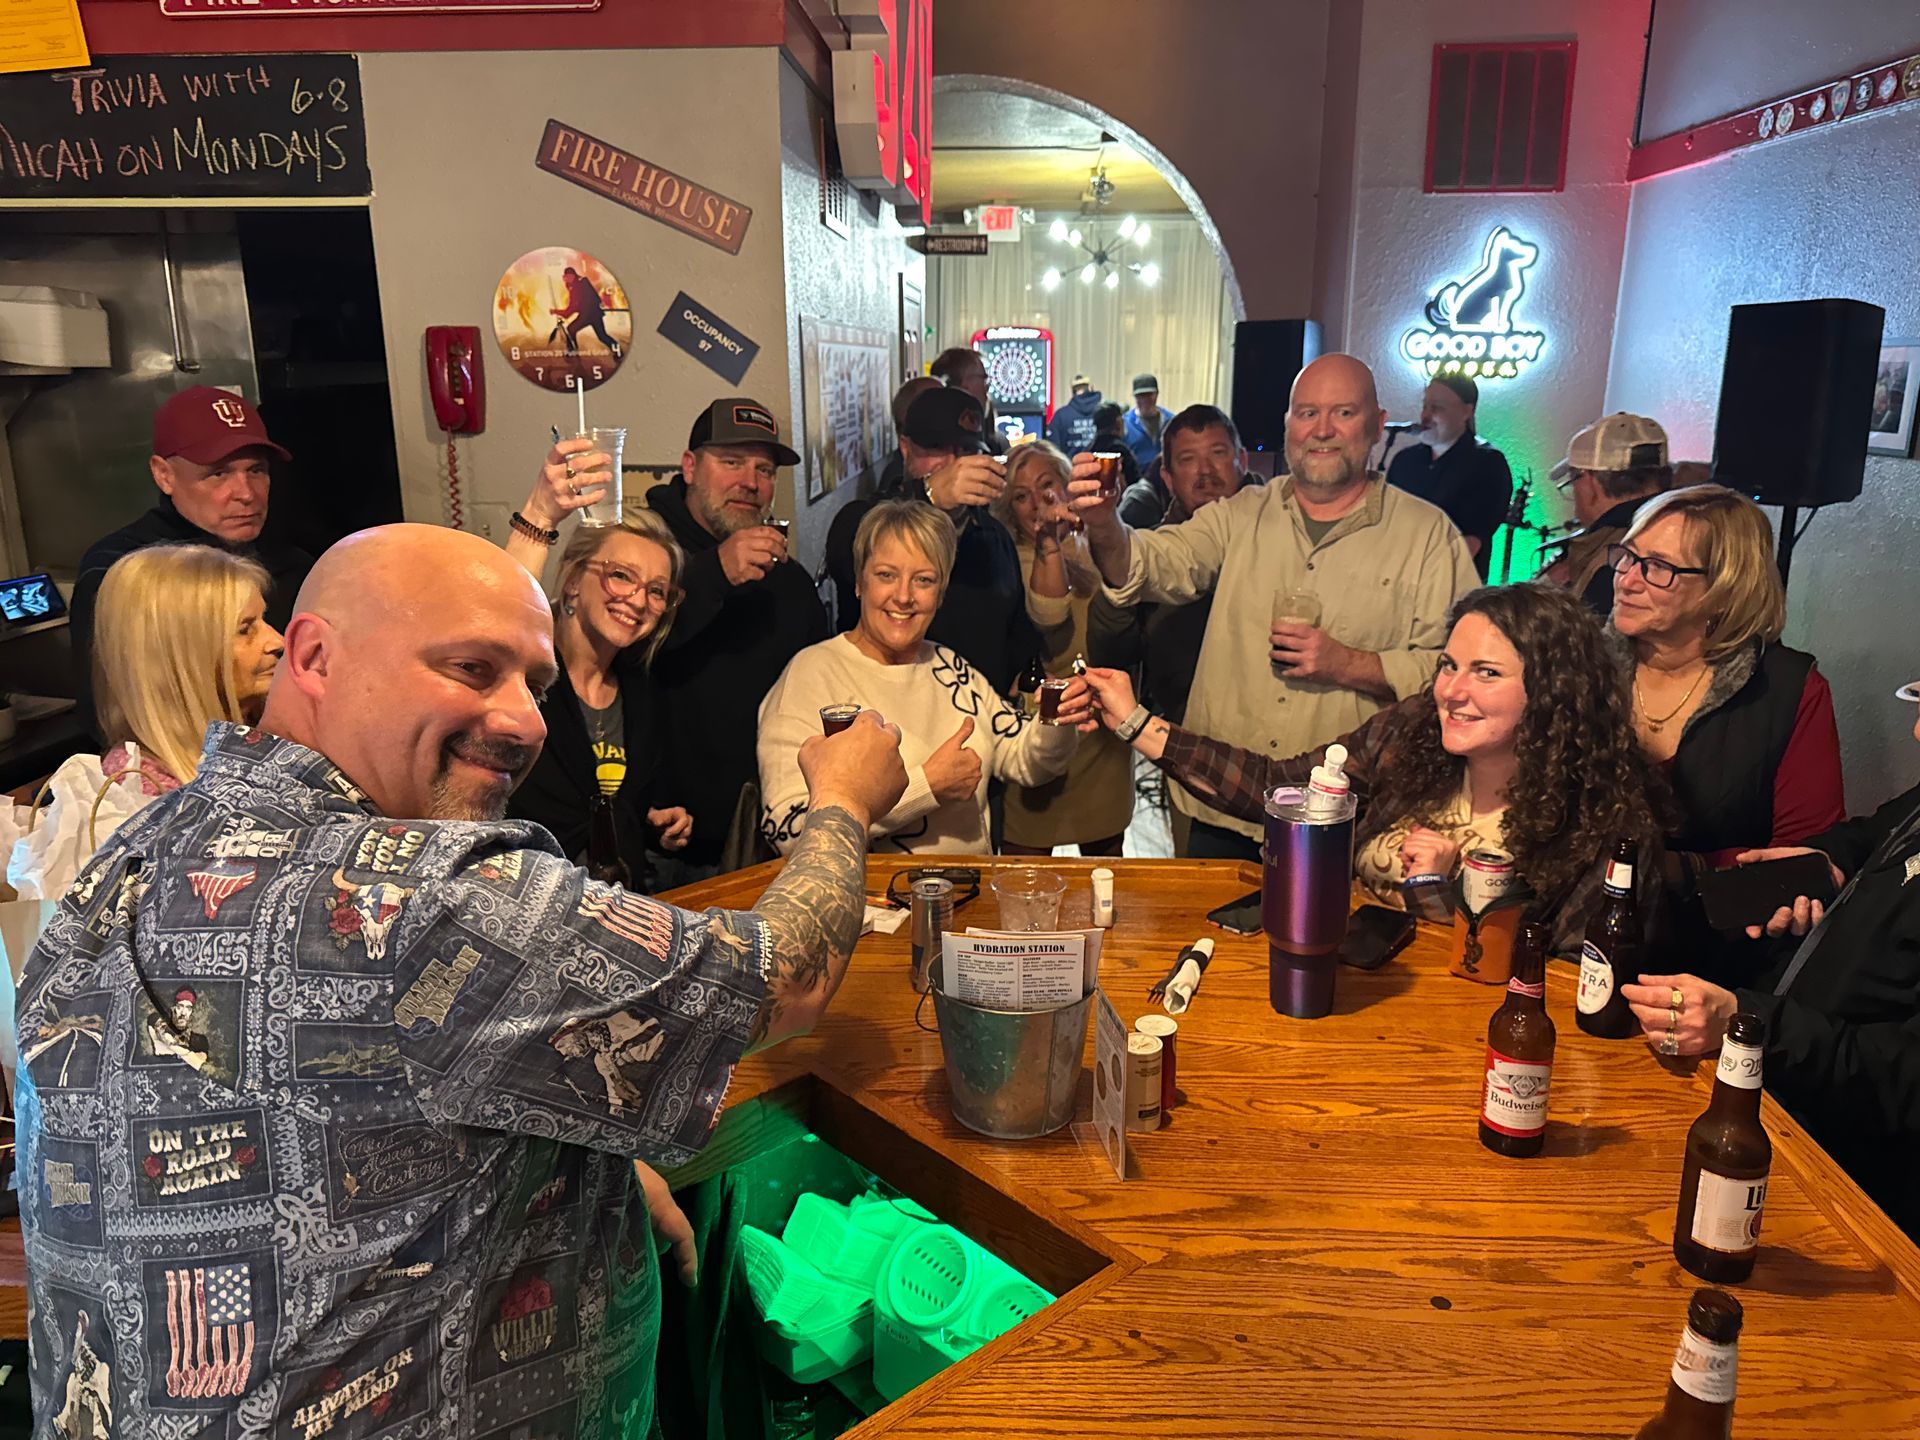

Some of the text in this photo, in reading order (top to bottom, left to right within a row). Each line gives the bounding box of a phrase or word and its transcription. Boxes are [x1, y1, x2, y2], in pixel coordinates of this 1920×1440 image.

[52, 68, 168, 115] TRIVIA
[183, 64, 271, 103] WITH
[117, 134, 164, 176] ON
[173, 117, 348, 182] MONDAYS
[550, 128, 739, 241] FIRE HOUSE
[986, 207, 1014, 230] EXIT
[683, 309, 744, 356] OCCUPANCY
[698, 339, 712, 352] 97
[1406, 332, 1544, 361] GOOD BOY
[511, 346, 521, 361] 8
[611, 343, 622, 358] 4
[535, 366, 545, 381] 7
[564, 374, 575, 389] 6
[592, 366, 603, 380] 5
[973, 943, 1066, 954] HYDRATION STATION
[422, 944, 483, 1028] NELSON
[149, 1119, 248, 1154] ON THE
[166, 1140, 232, 1175] ROAD
[160, 1161, 242, 1196] AGAIN
[493, 1303, 559, 1352] WILLIE
[291, 1346, 414, 1430] ALWAYS ON
[304, 1371, 399, 1440] MY MIND
